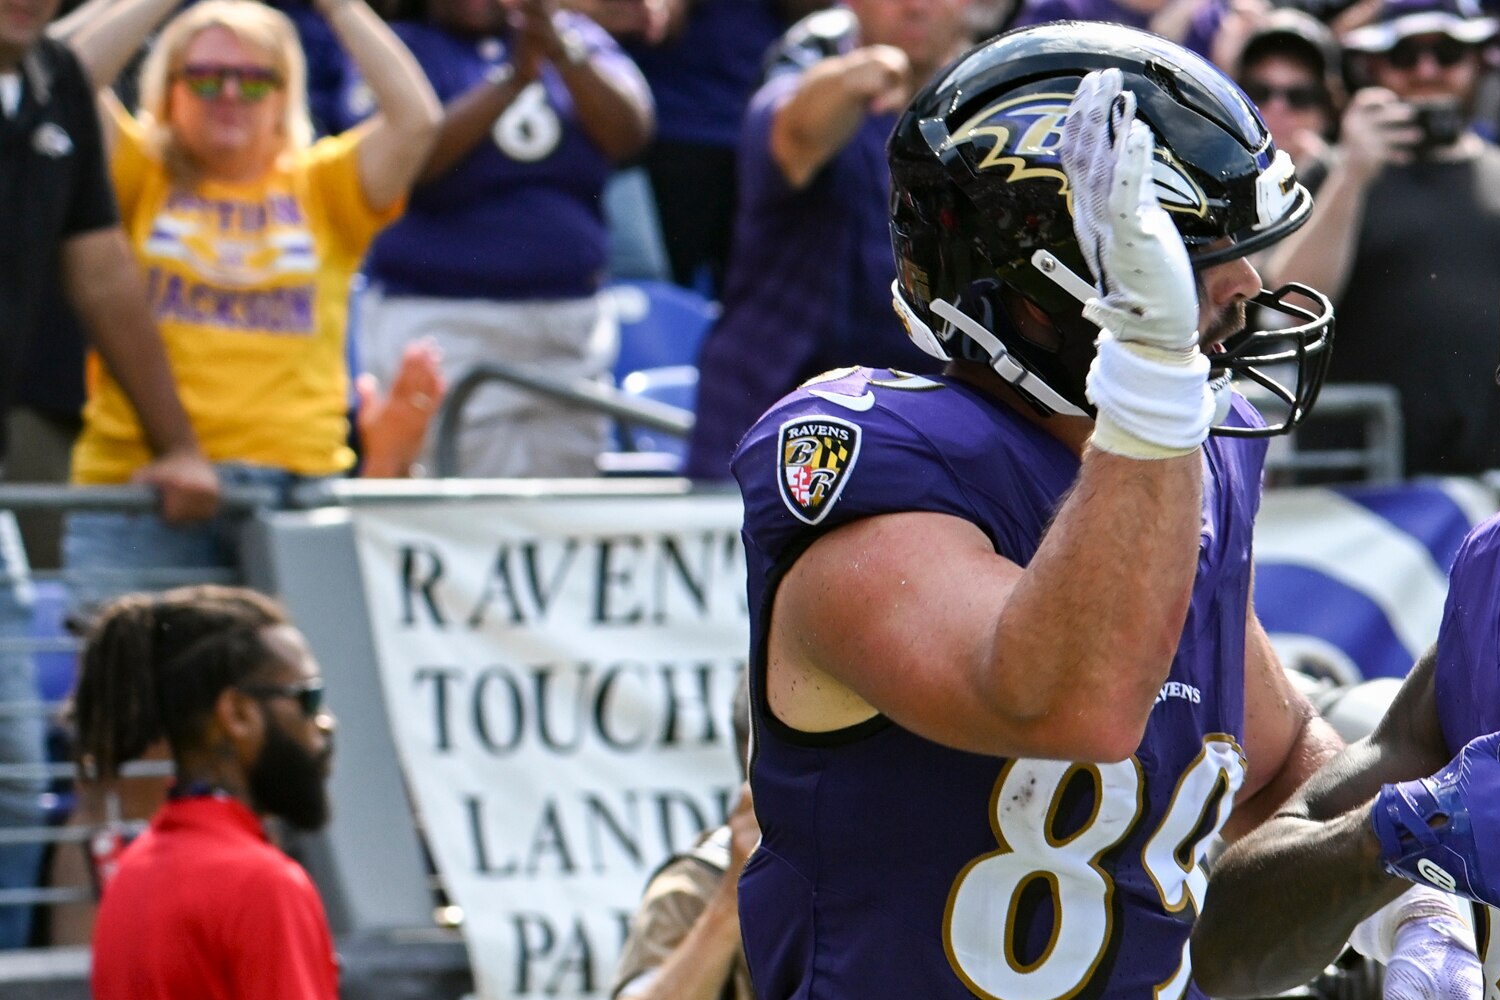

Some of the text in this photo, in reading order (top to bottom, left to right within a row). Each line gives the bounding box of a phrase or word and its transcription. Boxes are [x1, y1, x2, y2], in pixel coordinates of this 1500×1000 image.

[492, 80, 562, 163] 6
[787, 423, 850, 441] RAVENS
[787, 437, 819, 466] B
[809, 468, 837, 498] R
[397, 530, 750, 630] RAVEN'
[414, 655, 744, 758] TOUCH
[1153, 681, 1202, 705] VENS
